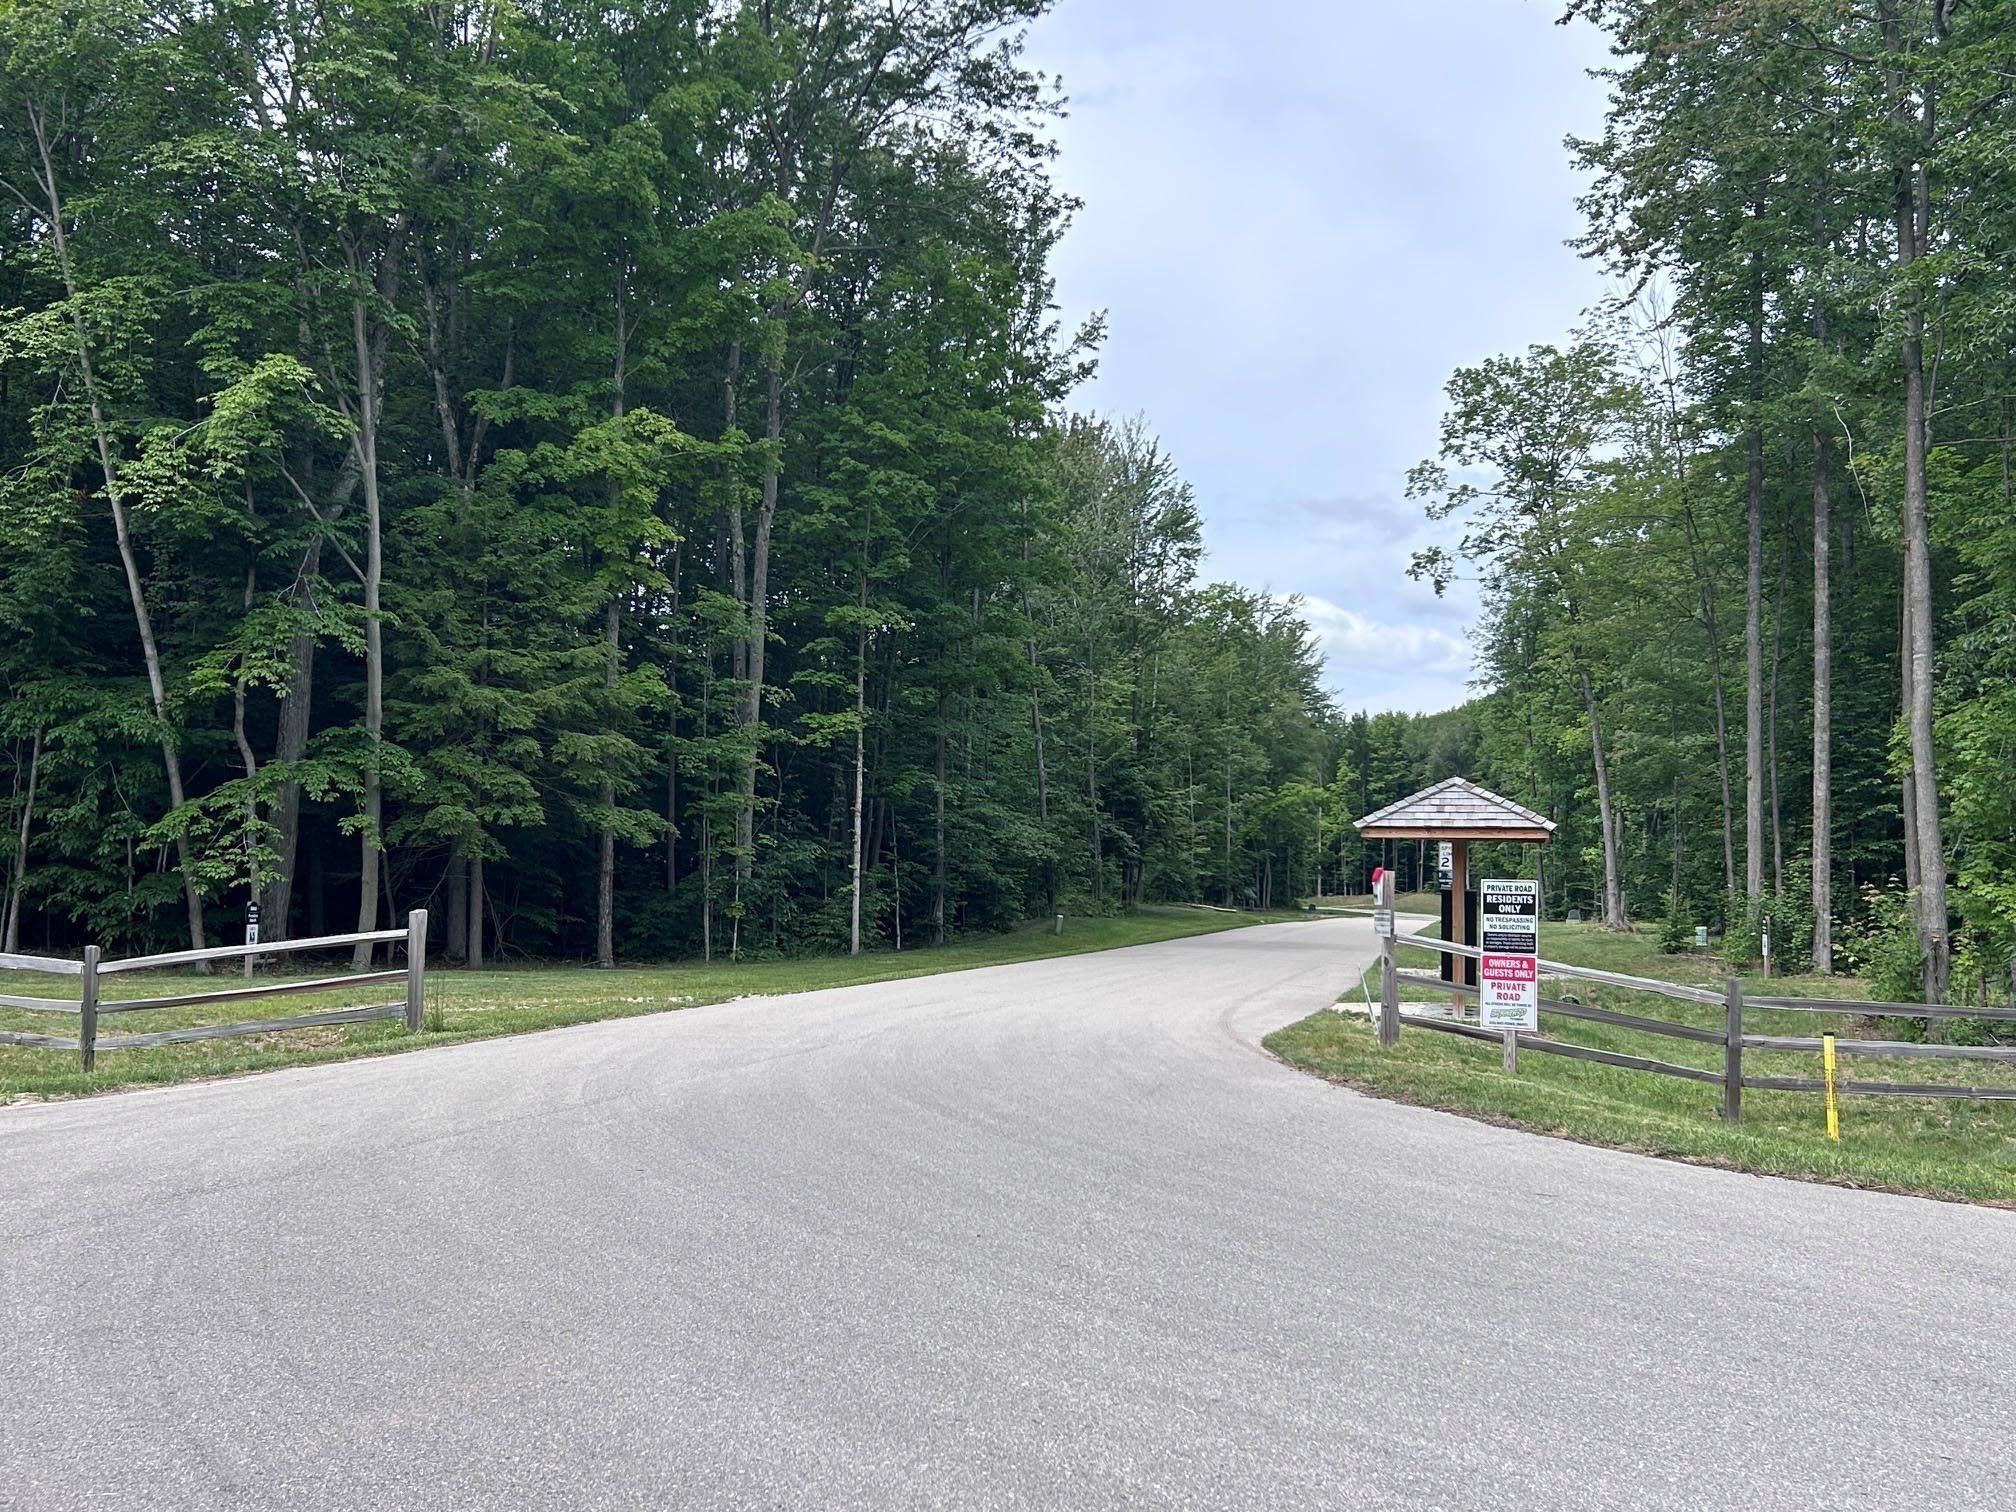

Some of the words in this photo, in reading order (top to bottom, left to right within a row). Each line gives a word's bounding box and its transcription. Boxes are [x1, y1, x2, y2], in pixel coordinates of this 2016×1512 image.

[1514, 885, 1533, 893] ROAD
[1486, 895, 1534, 904] RESIDENTS
[1498, 904, 1521, 914] ONLY
[1488, 959, 1521, 968] OWNERS
[1521, 960, 1529, 969] &
[1484, 968, 1513, 978] GUESTS
[1514, 969, 1534, 979] ONLY
[1491, 982, 1527, 991] PRIVATE
[1496, 992, 1521, 1001] ROAD
